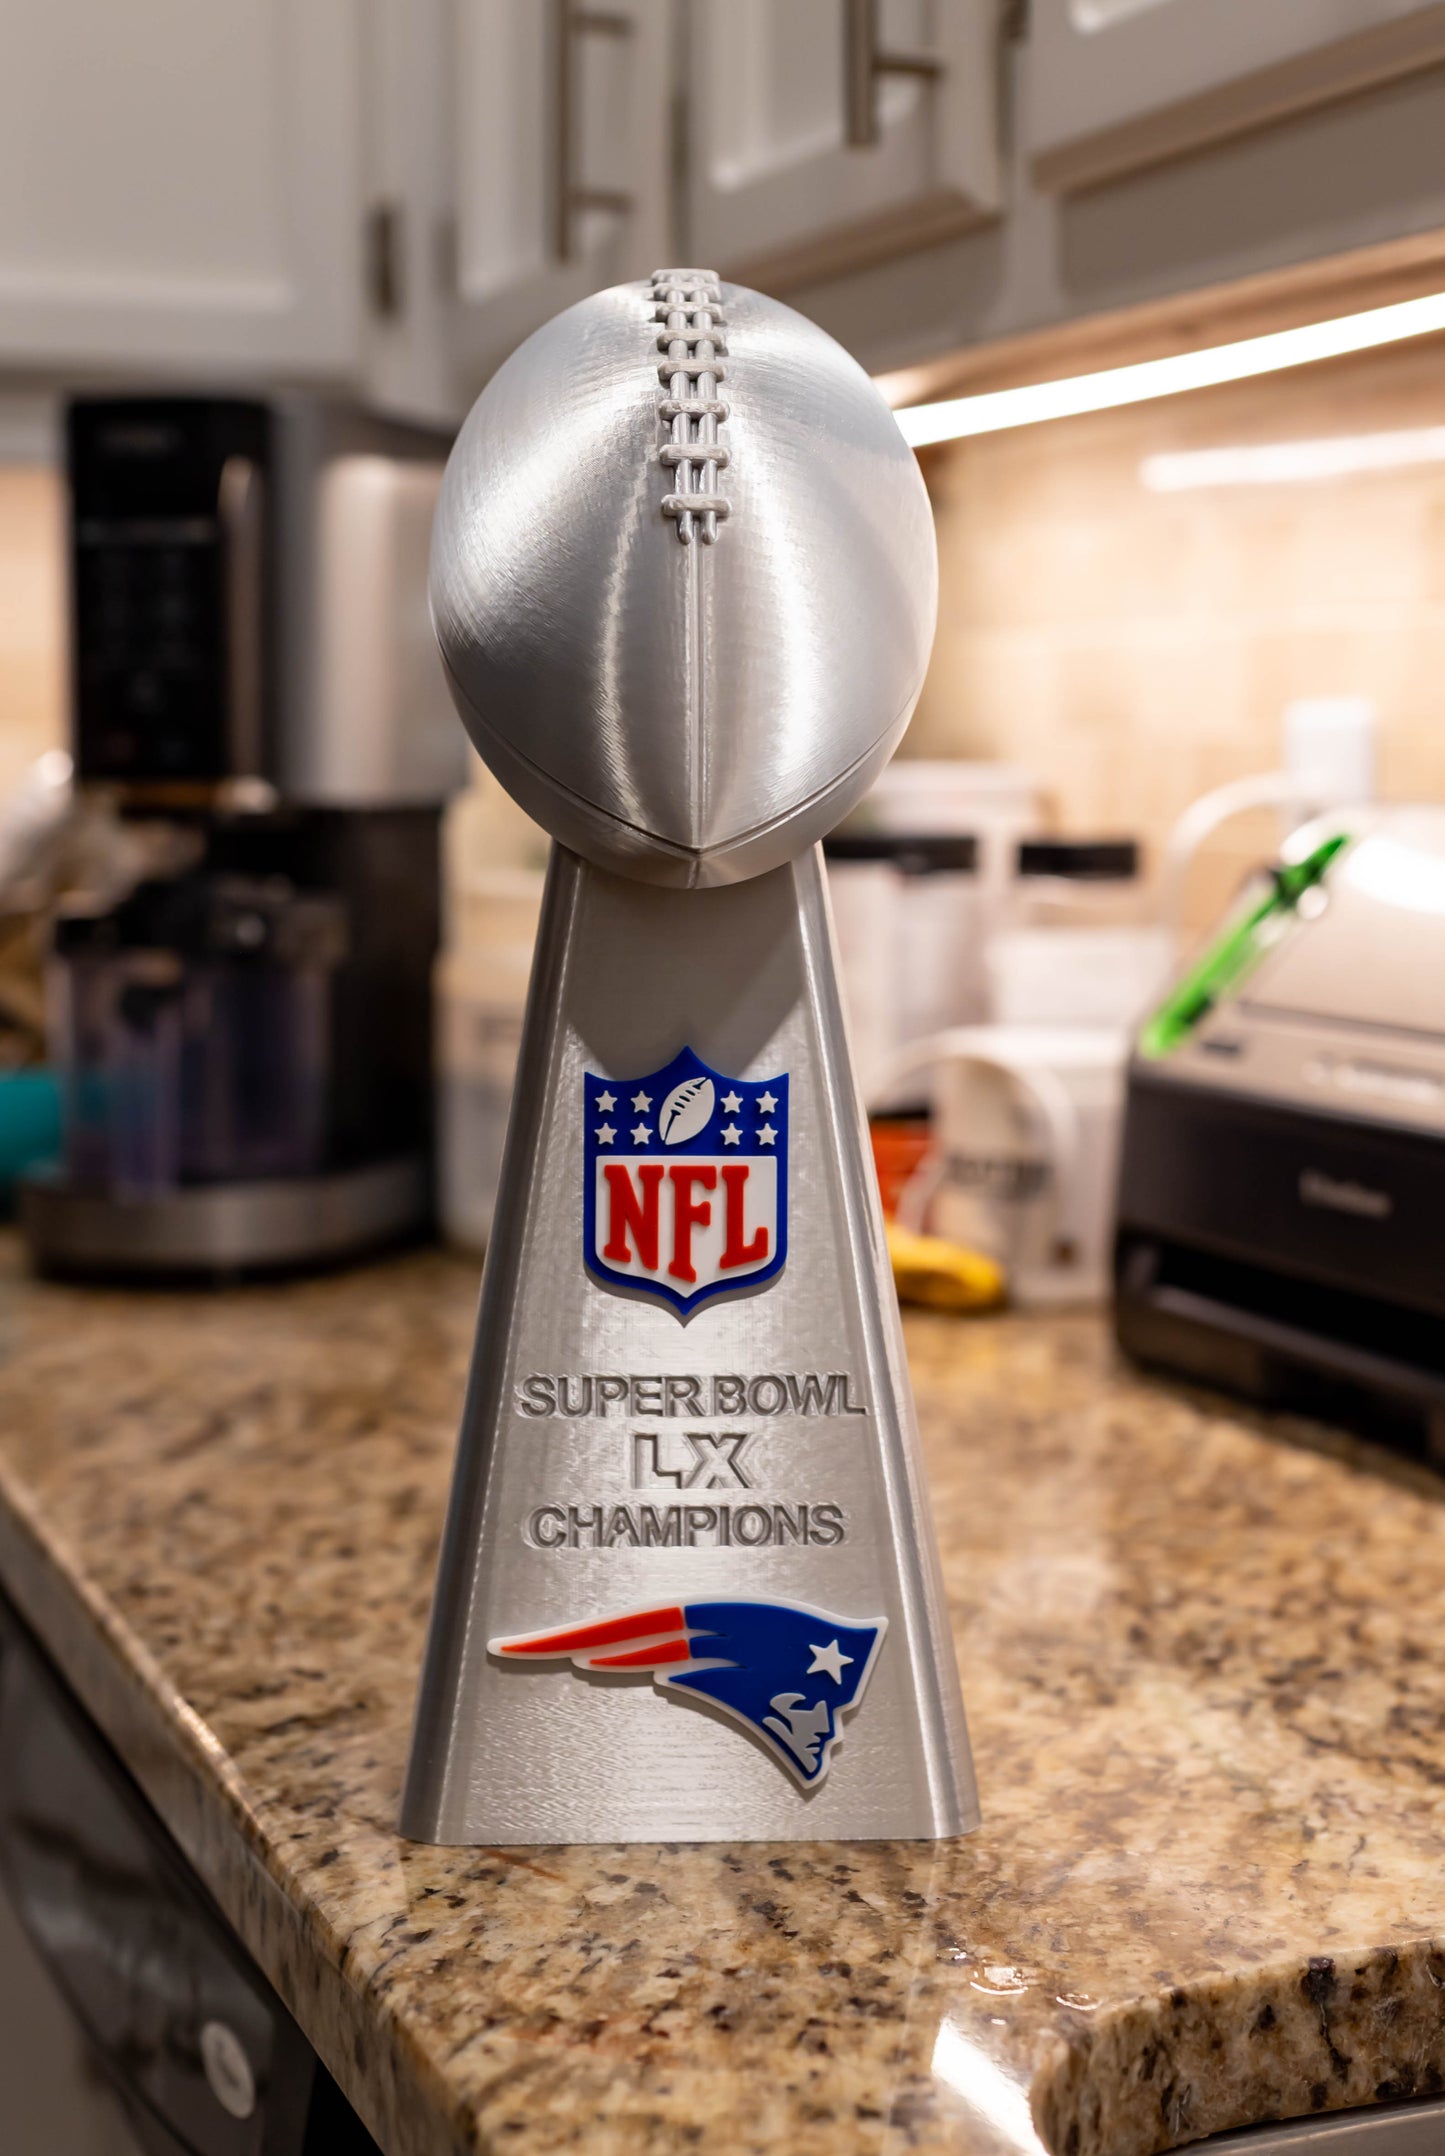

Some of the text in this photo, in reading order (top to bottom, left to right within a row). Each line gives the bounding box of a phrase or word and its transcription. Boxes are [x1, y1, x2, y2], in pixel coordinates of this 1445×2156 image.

[603, 1164, 769, 1283] NFL
[519, 1373, 868, 1417] SUPER BOWL
[634, 1432, 754, 1489] LX
[528, 1504, 846, 1548] CHAMPIONS
